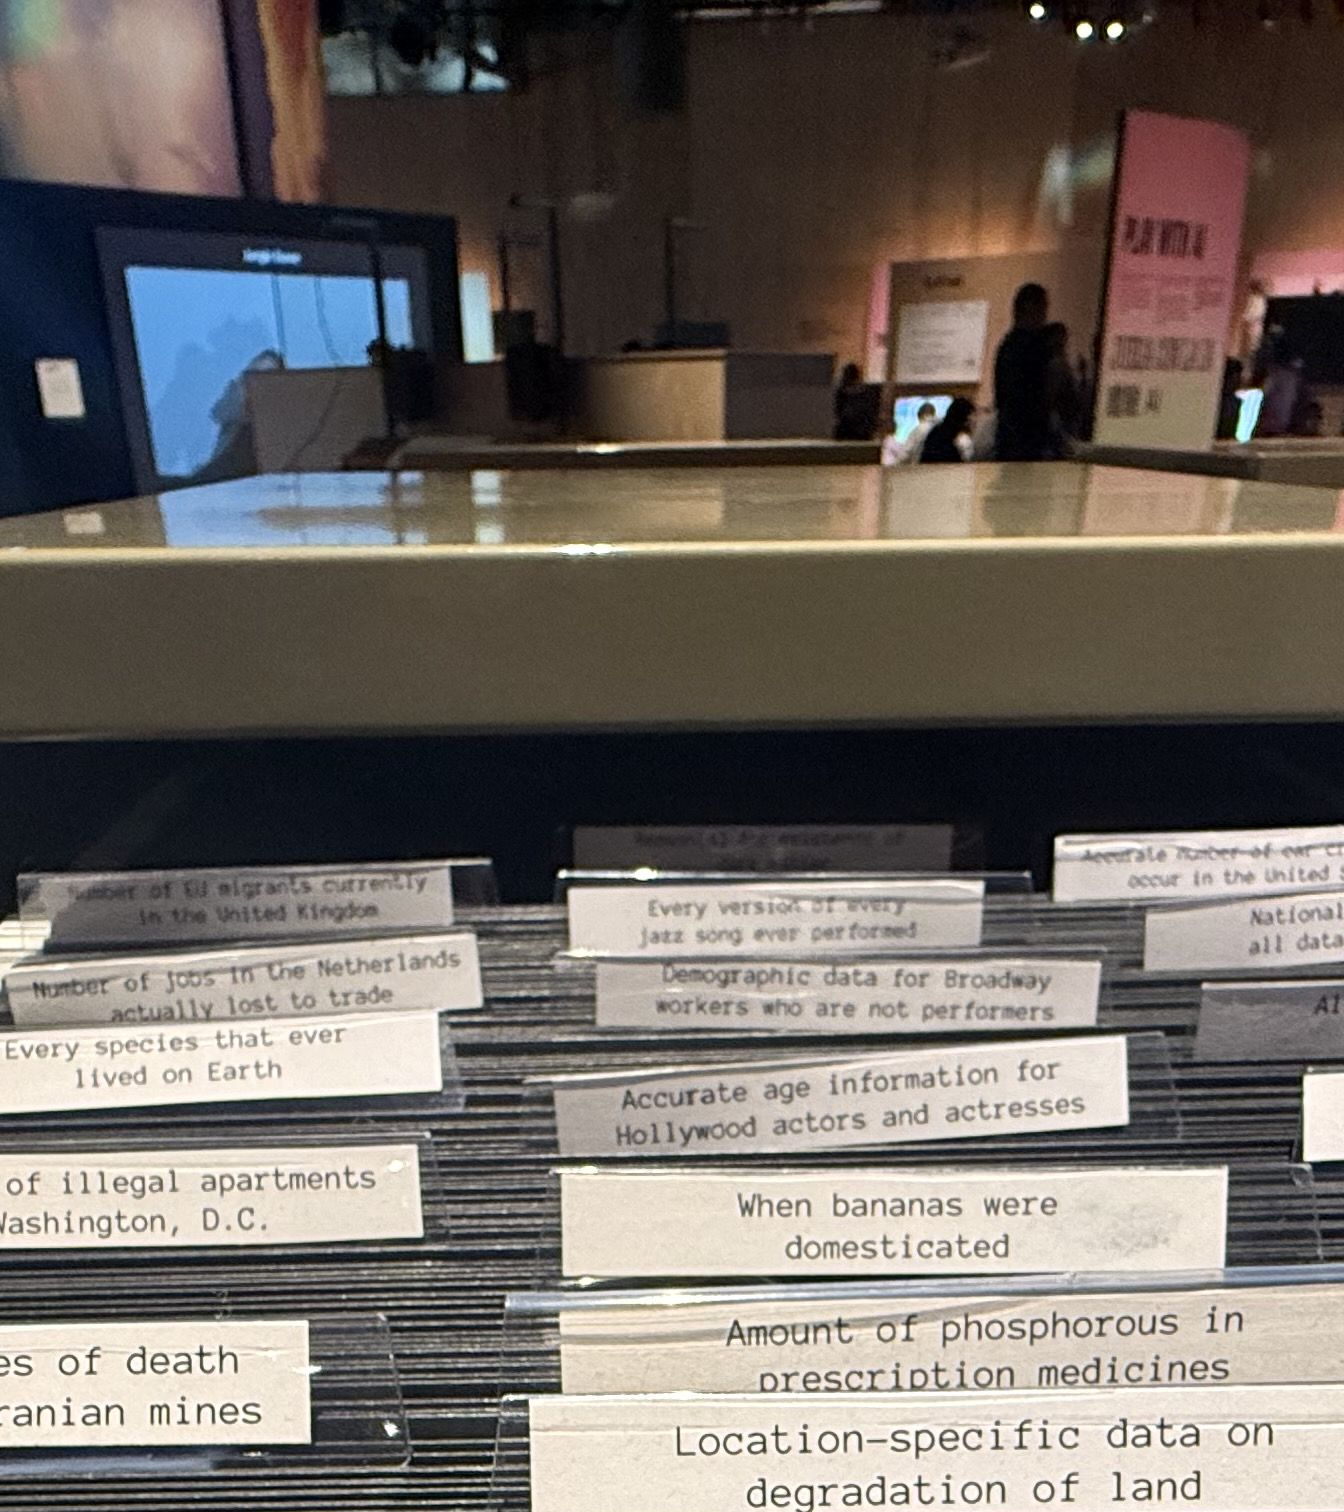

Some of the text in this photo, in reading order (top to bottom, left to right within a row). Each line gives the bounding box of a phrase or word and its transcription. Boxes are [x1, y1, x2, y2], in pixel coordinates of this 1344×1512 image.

[323, 873, 427, 895] currently
[1128, 874, 1179, 889] occur
[1194, 870, 1213, 886] in
[1224, 869, 1252, 885] the
[1265, 864, 1329, 883] United
[648, 897, 906, 920] Every version of every
[1250, 902, 1343, 926] National
[638, 921, 918, 949] jazz song ever performed
[1250, 934, 1282, 954] all
[1297, 932, 1343, 951] data
[32, 950, 460, 998] Number of jobs in the Netherlands
[662, 966, 1052, 995] Demographic data for Broadway
[111, 985, 392, 1024] actually lost to trade
[657, 996, 1053, 1023] workers who are not performers
[6, 1025, 346, 1062] Every species that ever
[76, 1060, 282, 1088] lived on Earth
[622, 1059, 1060, 1110] Accurate age information for
[616, 1097, 1085, 1147] Hollywood actors and actresses
[7, 1172, 40, 1196] of
[63, 1169, 178, 1199] illegal
[201, 1166, 376, 1197] apartments
[738, 1193, 1057, 1217] When bananas were
[201, 1207, 269, 1233] D.C.
[785, 1234, 1009, 1259] domesticated
[726, 1306, 1243, 1346] Amount of phosphorous in
[59, 1347, 101, 1375] of
[127, 1345, 238, 1375] death
[758, 1355, 1232, 1392] prescription medicines
[150, 1396, 261, 1425] mines
[677, 1418, 1273, 1459] Location-specific data on
[1033, 1472, 1079, 1503] of
[1112, 1471, 1200, 1501] land
